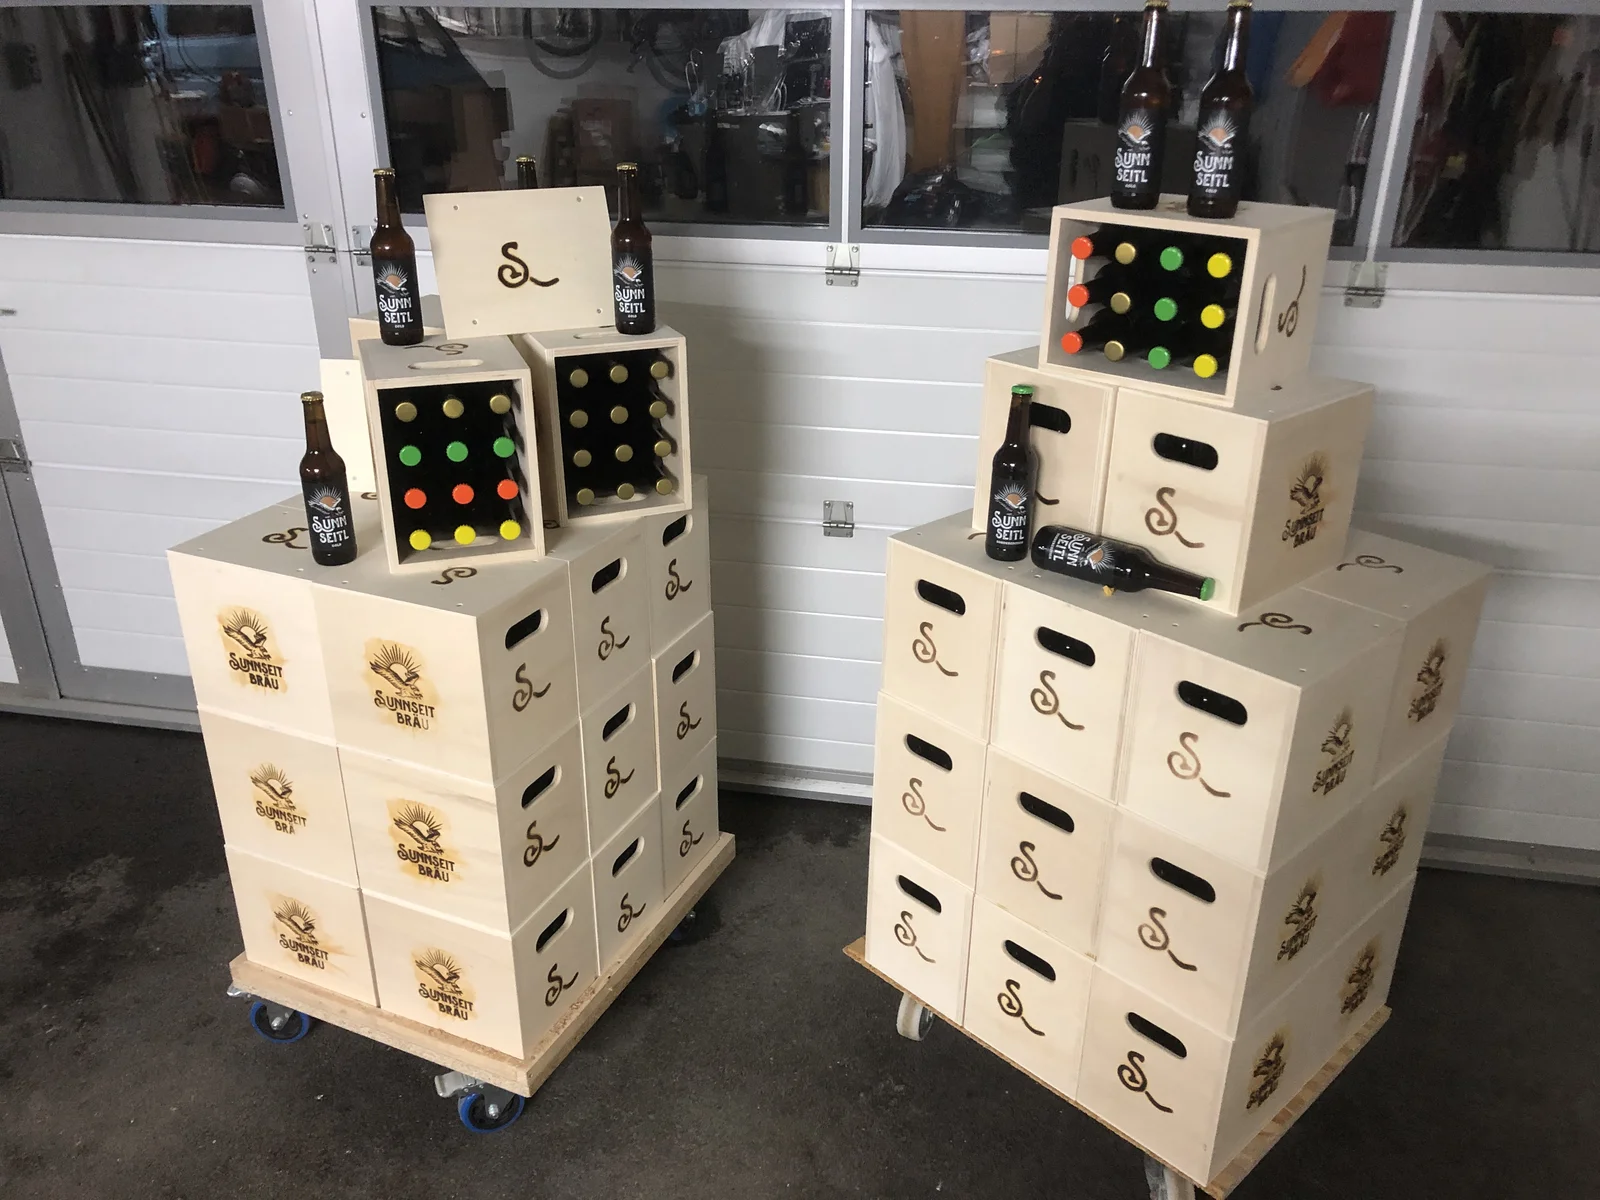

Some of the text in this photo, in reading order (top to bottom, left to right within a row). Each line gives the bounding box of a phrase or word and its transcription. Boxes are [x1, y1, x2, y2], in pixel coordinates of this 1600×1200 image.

[1114, 147, 1151, 169] SUNN
[1193, 150, 1234, 173] SUNN
[1116, 168, 1148, 183] SEITL
[1195, 172, 1230, 188] SEITL
[379, 294, 412, 312] SUNN
[614, 284, 646, 303] SUNN
[618, 301, 646, 314] SEITL
[384, 311, 413, 324] SEITL
[312, 515, 347, 533] SUNN
[991, 510, 1027, 530] SUNN
[319, 529, 350, 544] SEITL
[995, 528, 1025, 541] SEITL
[1052, 533, 1073, 561] SEITL
[1066, 533, 1091, 567] SUNN
[228, 651, 283, 678] SUNNSEIT
[249, 673, 279, 690] BRÄU
[373, 689, 435, 718] SUNNSEIT
[396, 712, 429, 730] BRÄU
[255, 800, 307, 827] SUNNSEIT
[397, 843, 455, 872] SUNNSEIT
[417, 864, 450, 882] BRÄU
[279, 933, 329, 961] SUNNSEIT
[418, 982, 473, 1011] SUNNSEIT
[438, 1002, 468, 1021] BRÄU
